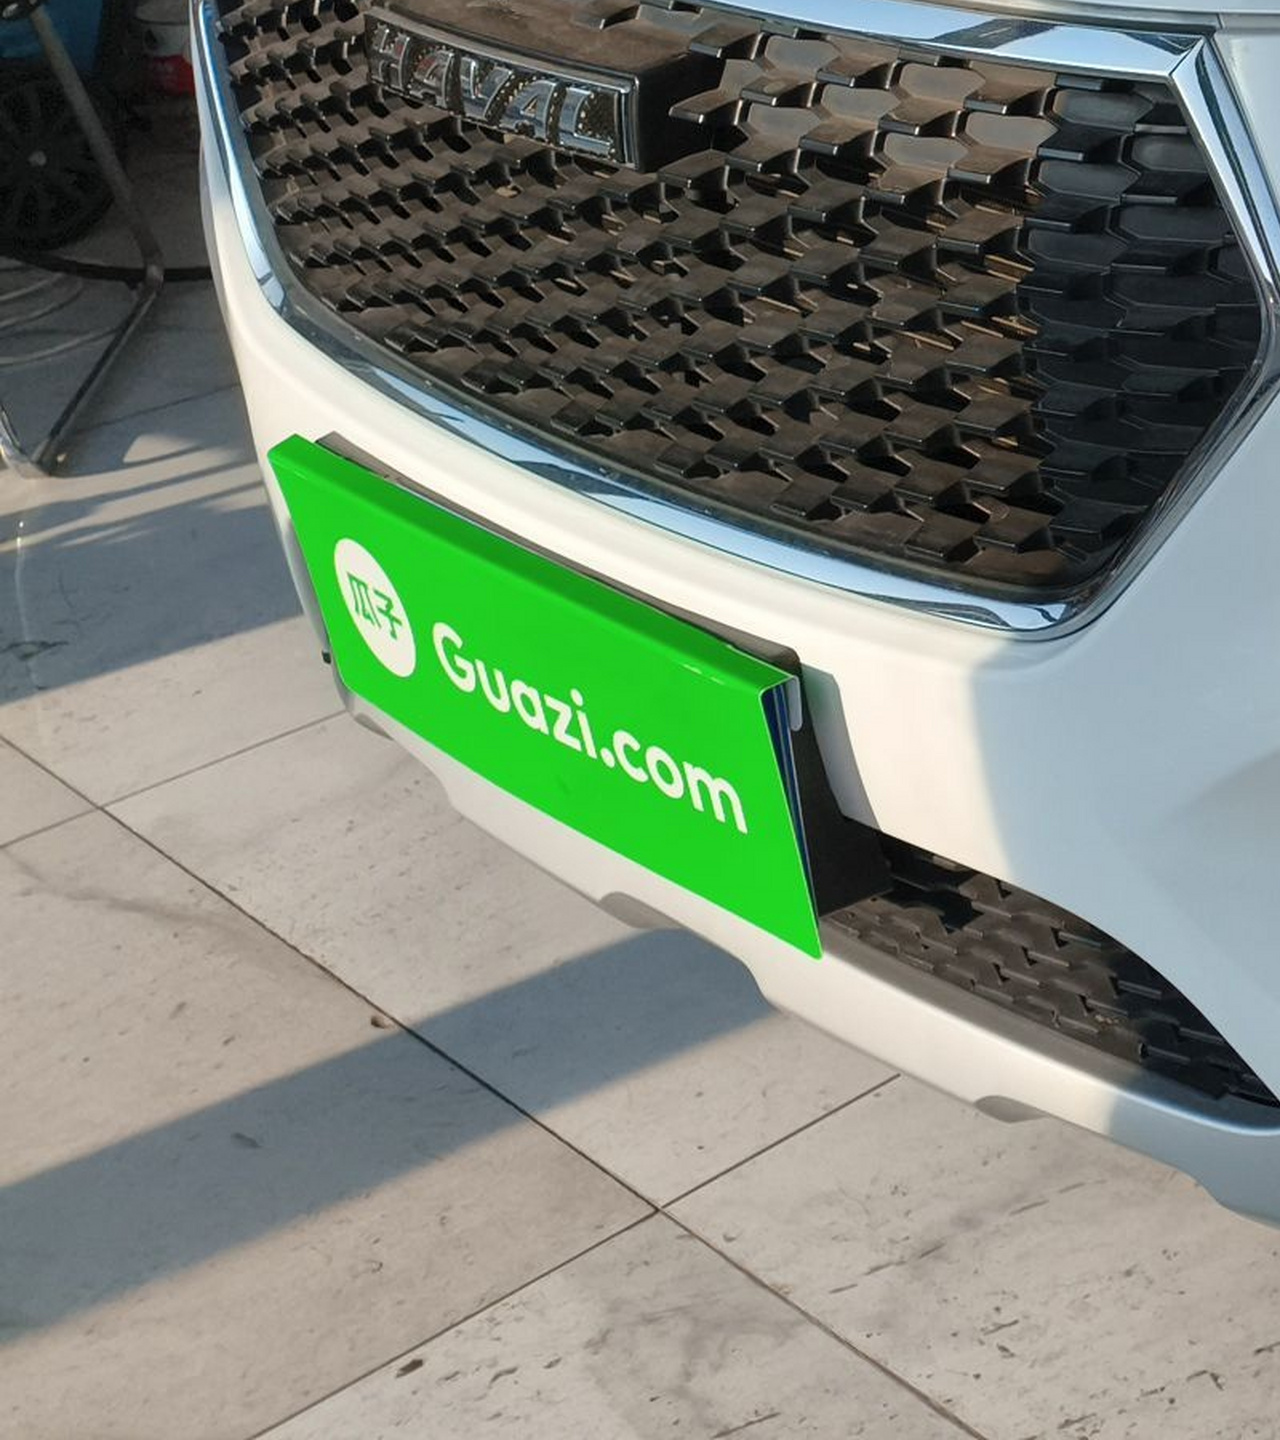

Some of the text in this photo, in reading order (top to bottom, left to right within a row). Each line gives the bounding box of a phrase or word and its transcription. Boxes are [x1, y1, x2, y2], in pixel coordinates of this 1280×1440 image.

[369, 23, 614, 157] HAVAL
[346, 571, 403, 640] 瓜子
[432, 611, 749, 835] Guazi.com
